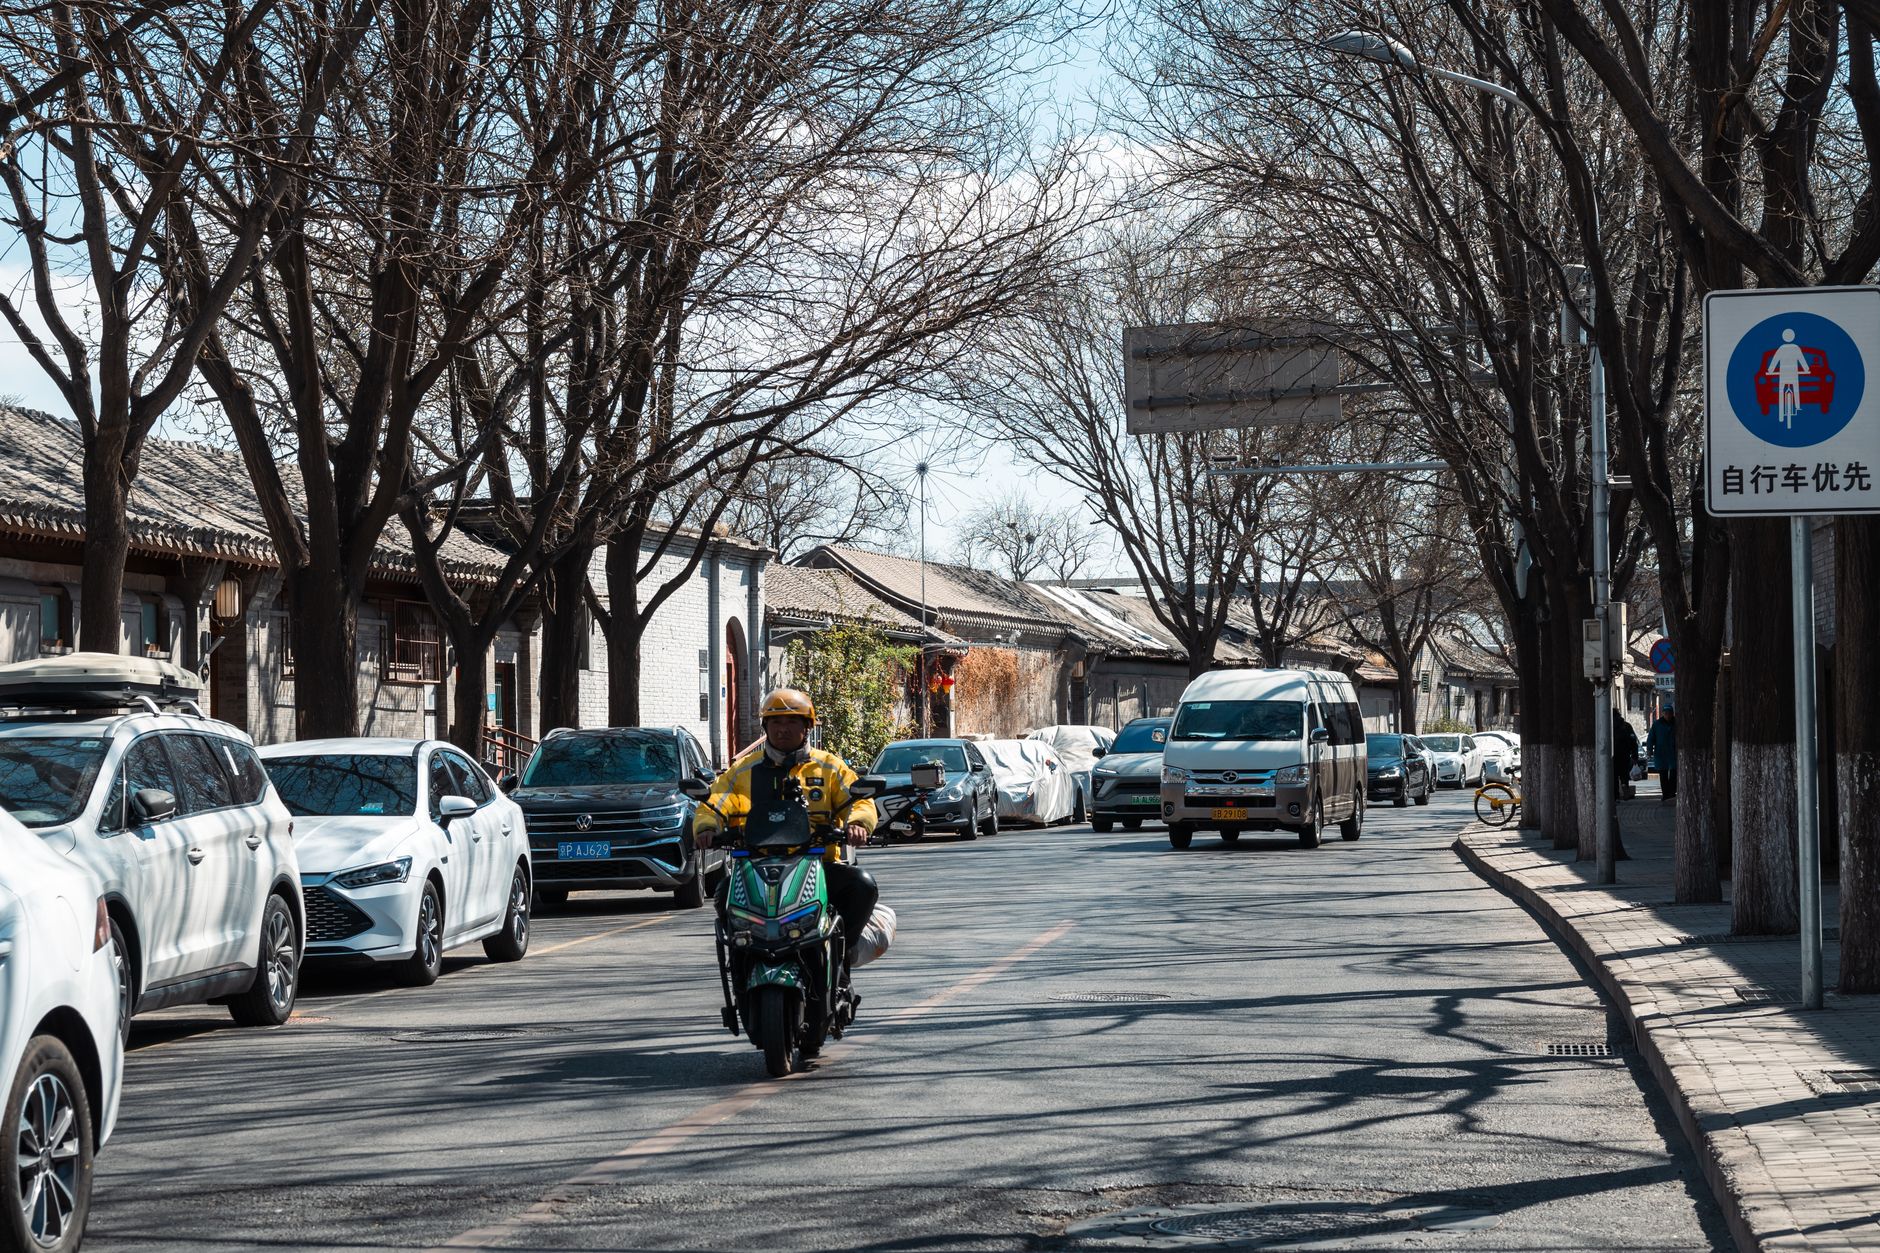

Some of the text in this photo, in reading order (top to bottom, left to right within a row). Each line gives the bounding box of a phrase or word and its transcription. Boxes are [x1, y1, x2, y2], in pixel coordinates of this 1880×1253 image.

[1722, 461, 1872, 495] 自行车优先
